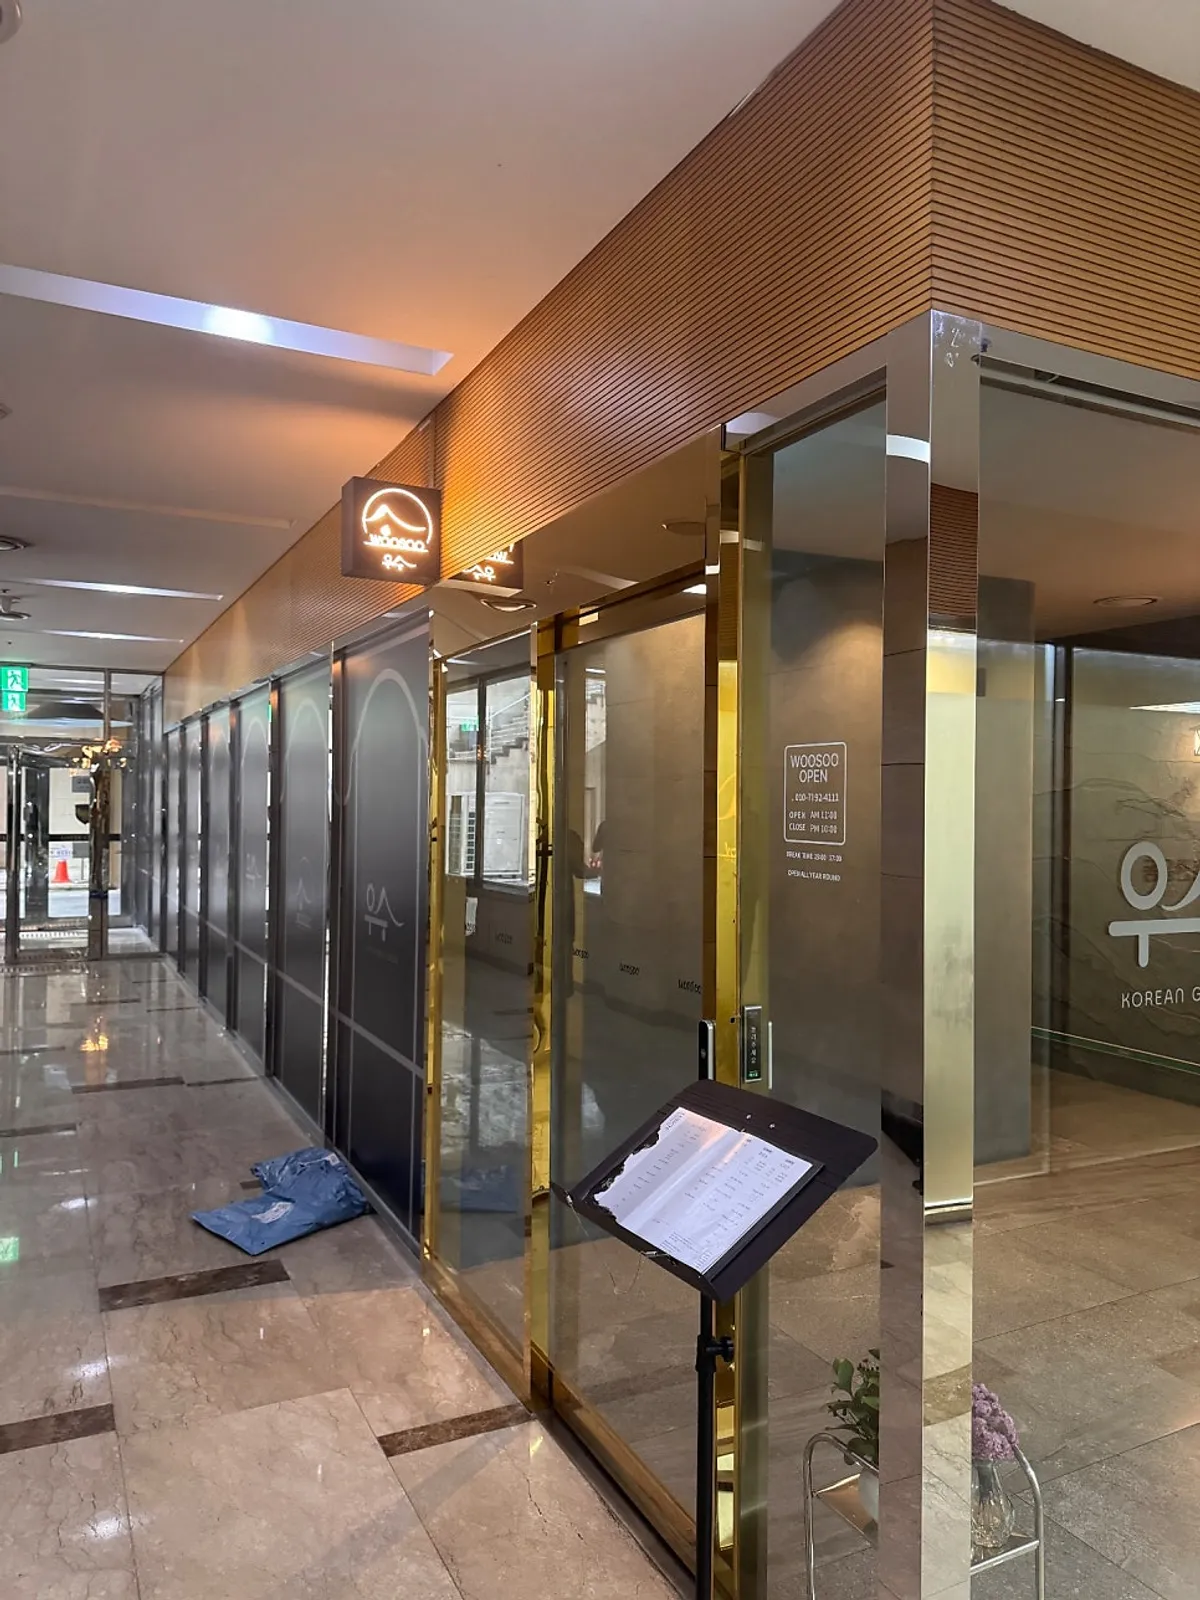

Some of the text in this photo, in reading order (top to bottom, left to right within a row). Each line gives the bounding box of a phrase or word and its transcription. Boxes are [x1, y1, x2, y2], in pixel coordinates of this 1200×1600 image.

[369, 533, 425, 551] WOOSOO
[790, 753, 839, 768] WOOSOO
[799, 769, 828, 783] OPEN
[789, 811, 806, 819] OPEN
[810, 811, 820, 819] AM
[789, 823, 806, 831] CLOSE
[810, 824, 820, 833] PM
[1121, 987, 1185, 1009] KOREAN
